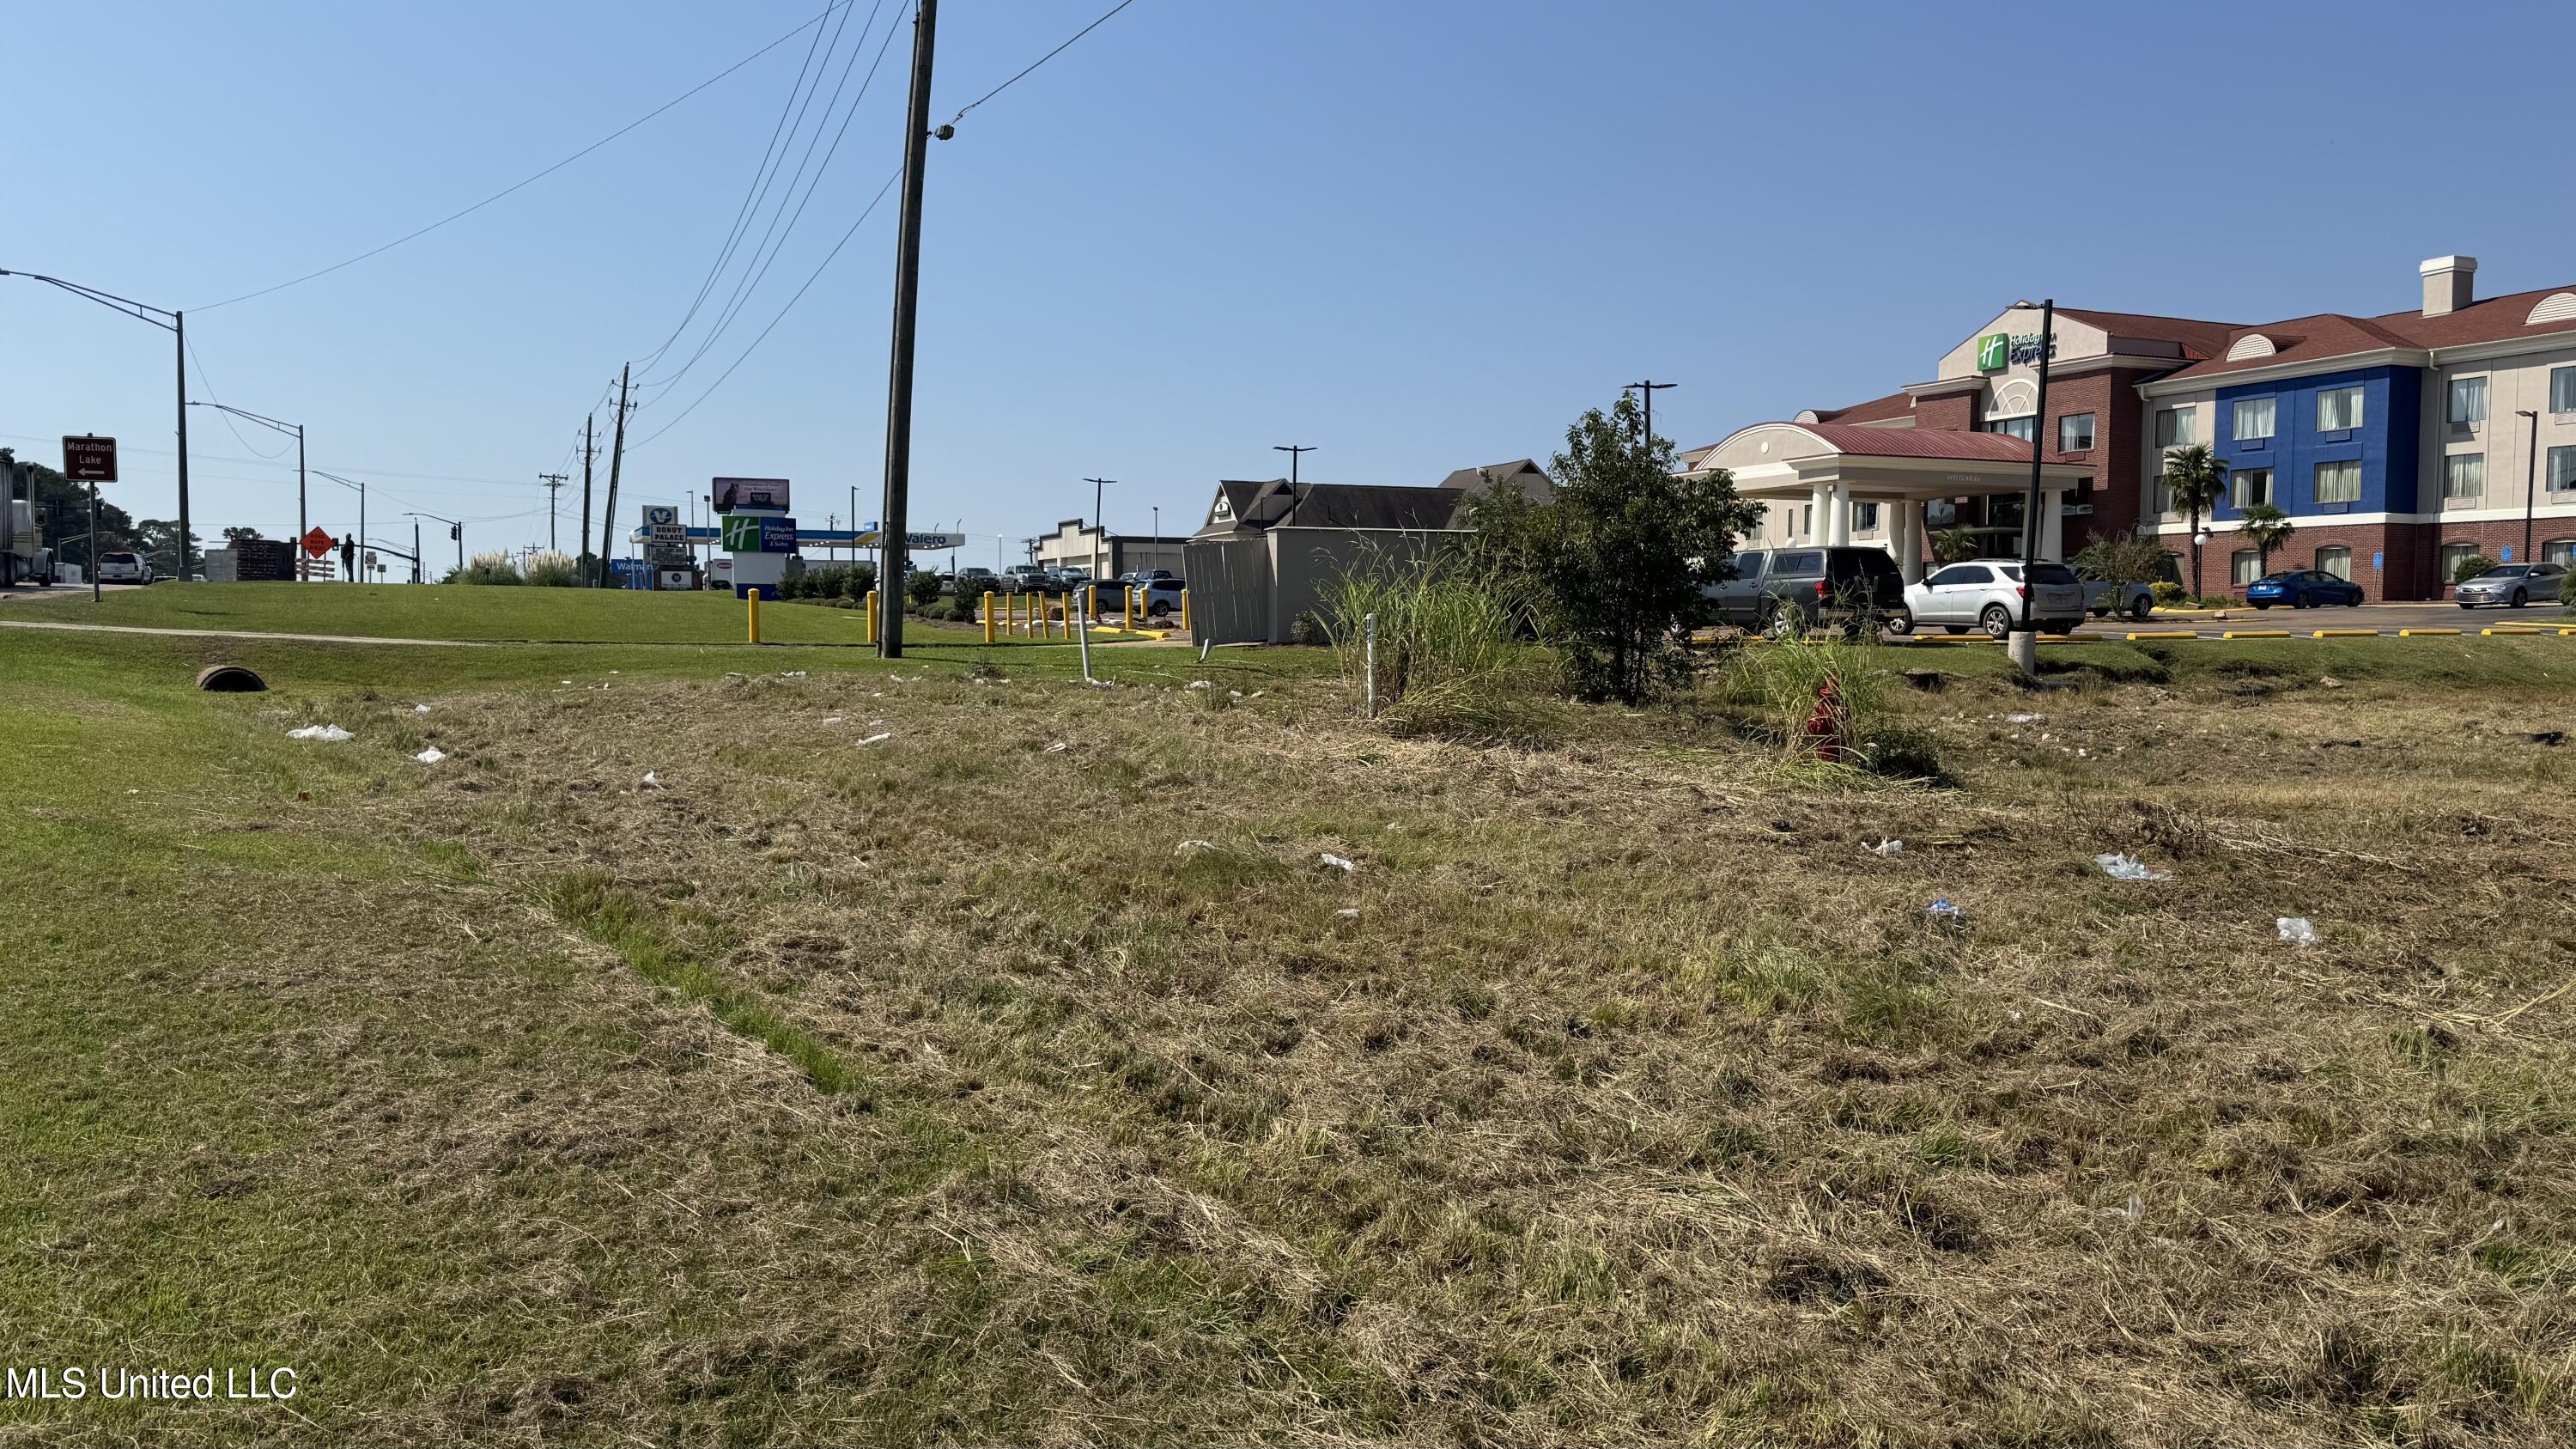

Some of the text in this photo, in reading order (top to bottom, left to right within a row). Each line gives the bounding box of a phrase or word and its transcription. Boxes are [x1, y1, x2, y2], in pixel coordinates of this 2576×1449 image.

[2010, 332, 2041, 346] Holiday
[67, 441, 112, 452] Marathon
[79, 454, 101, 464] Lake
[764, 532, 794, 541] Express
[905, 533, 946, 544] Valero
